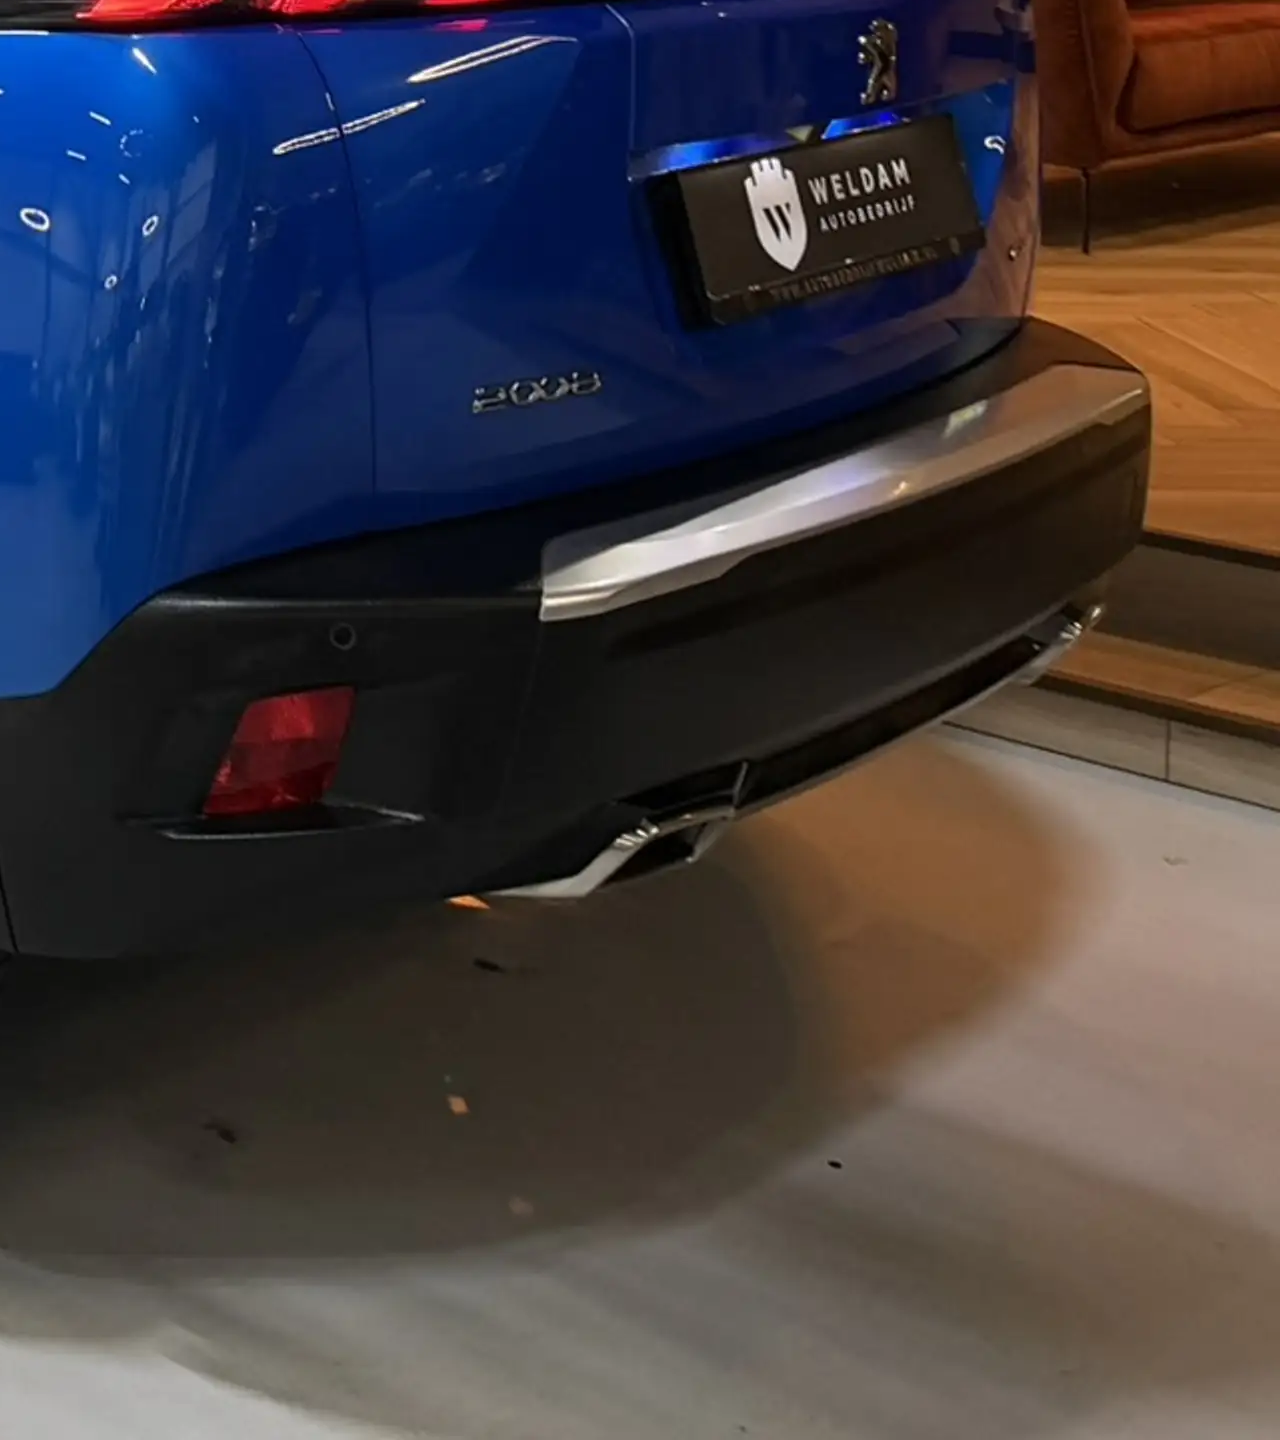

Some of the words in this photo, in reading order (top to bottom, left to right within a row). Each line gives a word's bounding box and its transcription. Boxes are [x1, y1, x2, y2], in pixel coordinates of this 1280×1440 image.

[808, 157, 911, 206] WELDAM
[819, 194, 916, 233] AUTOBEDRIJF
[472, 371, 602, 414] 2008
